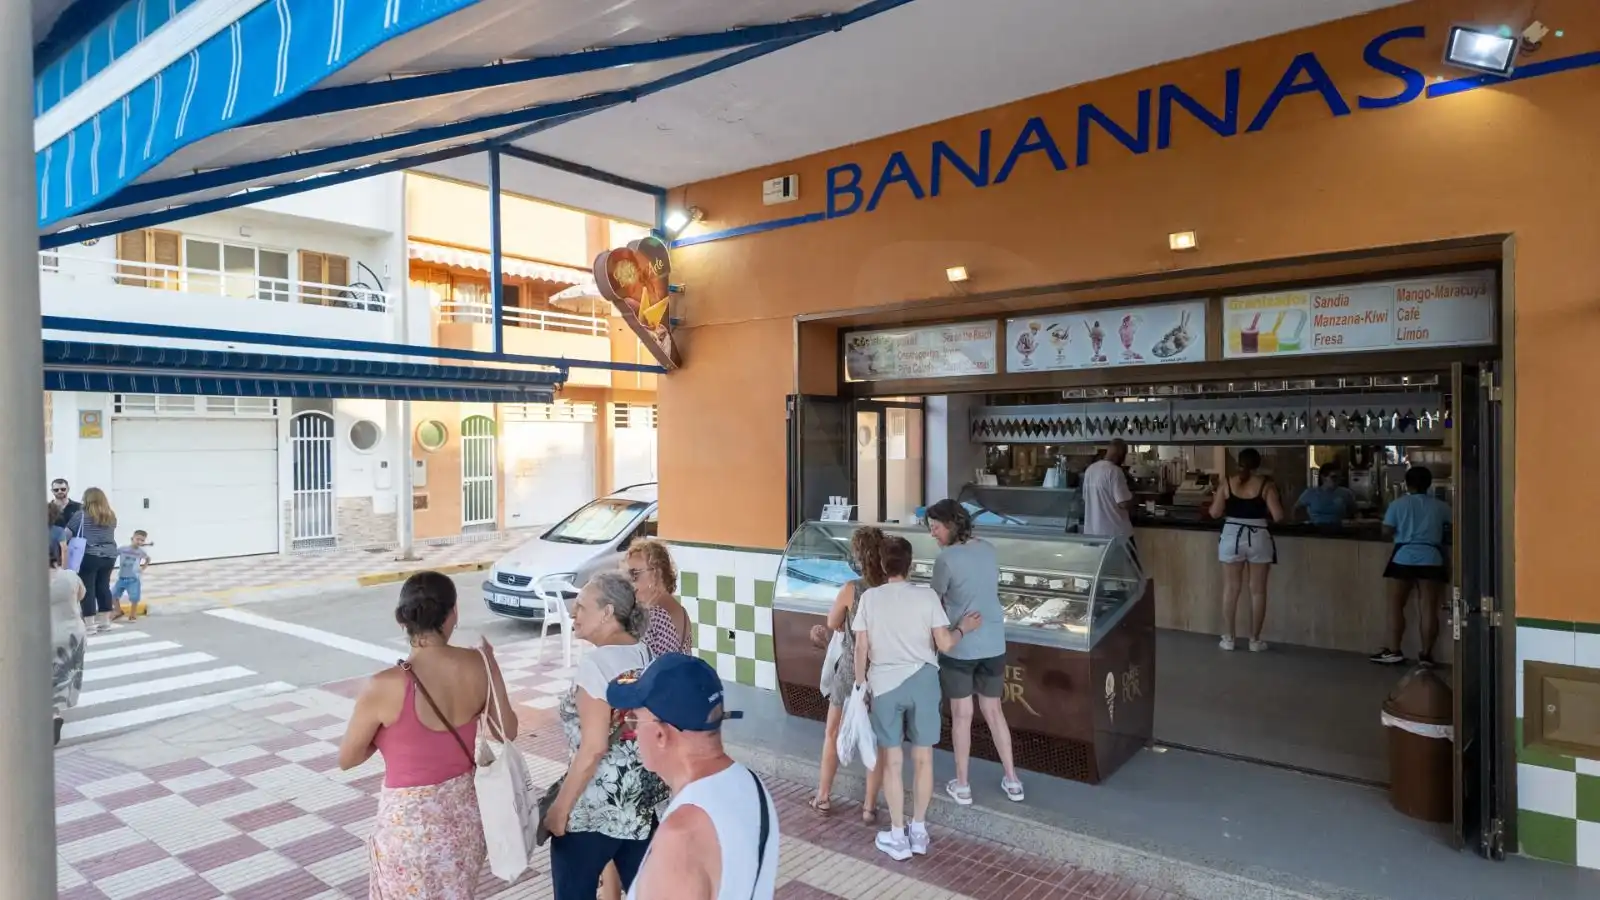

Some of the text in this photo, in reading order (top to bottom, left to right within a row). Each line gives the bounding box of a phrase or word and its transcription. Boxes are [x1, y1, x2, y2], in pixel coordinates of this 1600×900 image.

[825, 26, 1426, 219] BANANNAS
[1313, 309, 1389, 328] Manzana-Kiwi
[1397, 306, 1420, 322] Café
[1314, 333, 1343, 347] Fresa
